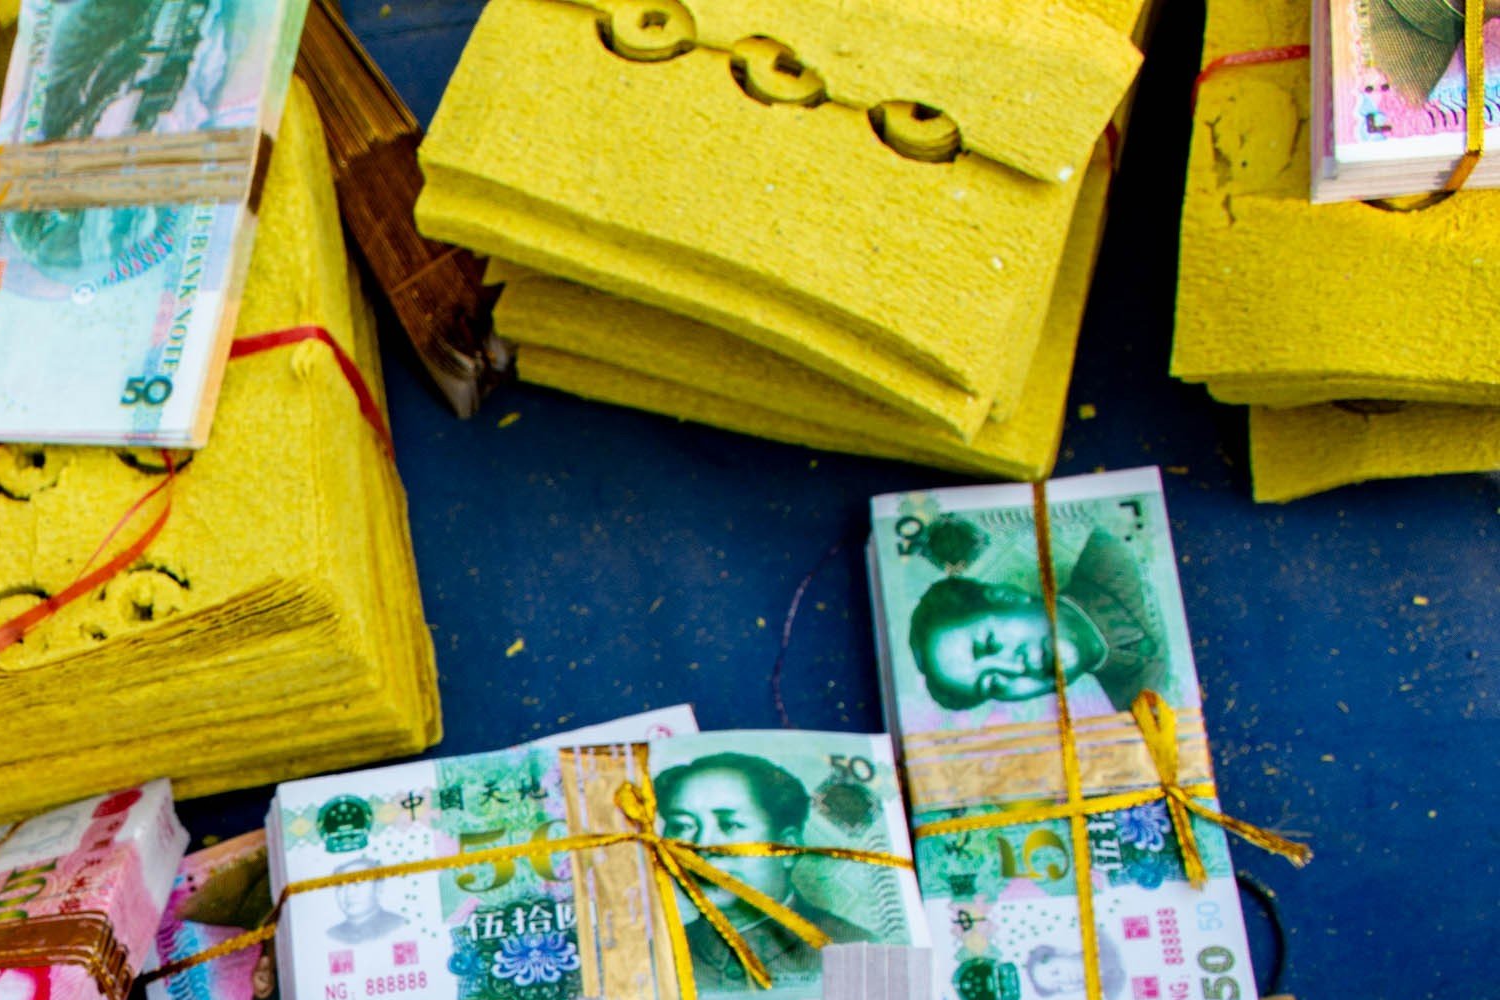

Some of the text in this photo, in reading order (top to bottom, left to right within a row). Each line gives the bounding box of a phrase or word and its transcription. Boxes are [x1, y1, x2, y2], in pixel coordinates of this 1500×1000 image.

[119, 376, 173, 406] 50
[895, 515, 924, 557] 50
[829, 754, 876, 784] 50
[401, 780, 562, 822] 中國天地
